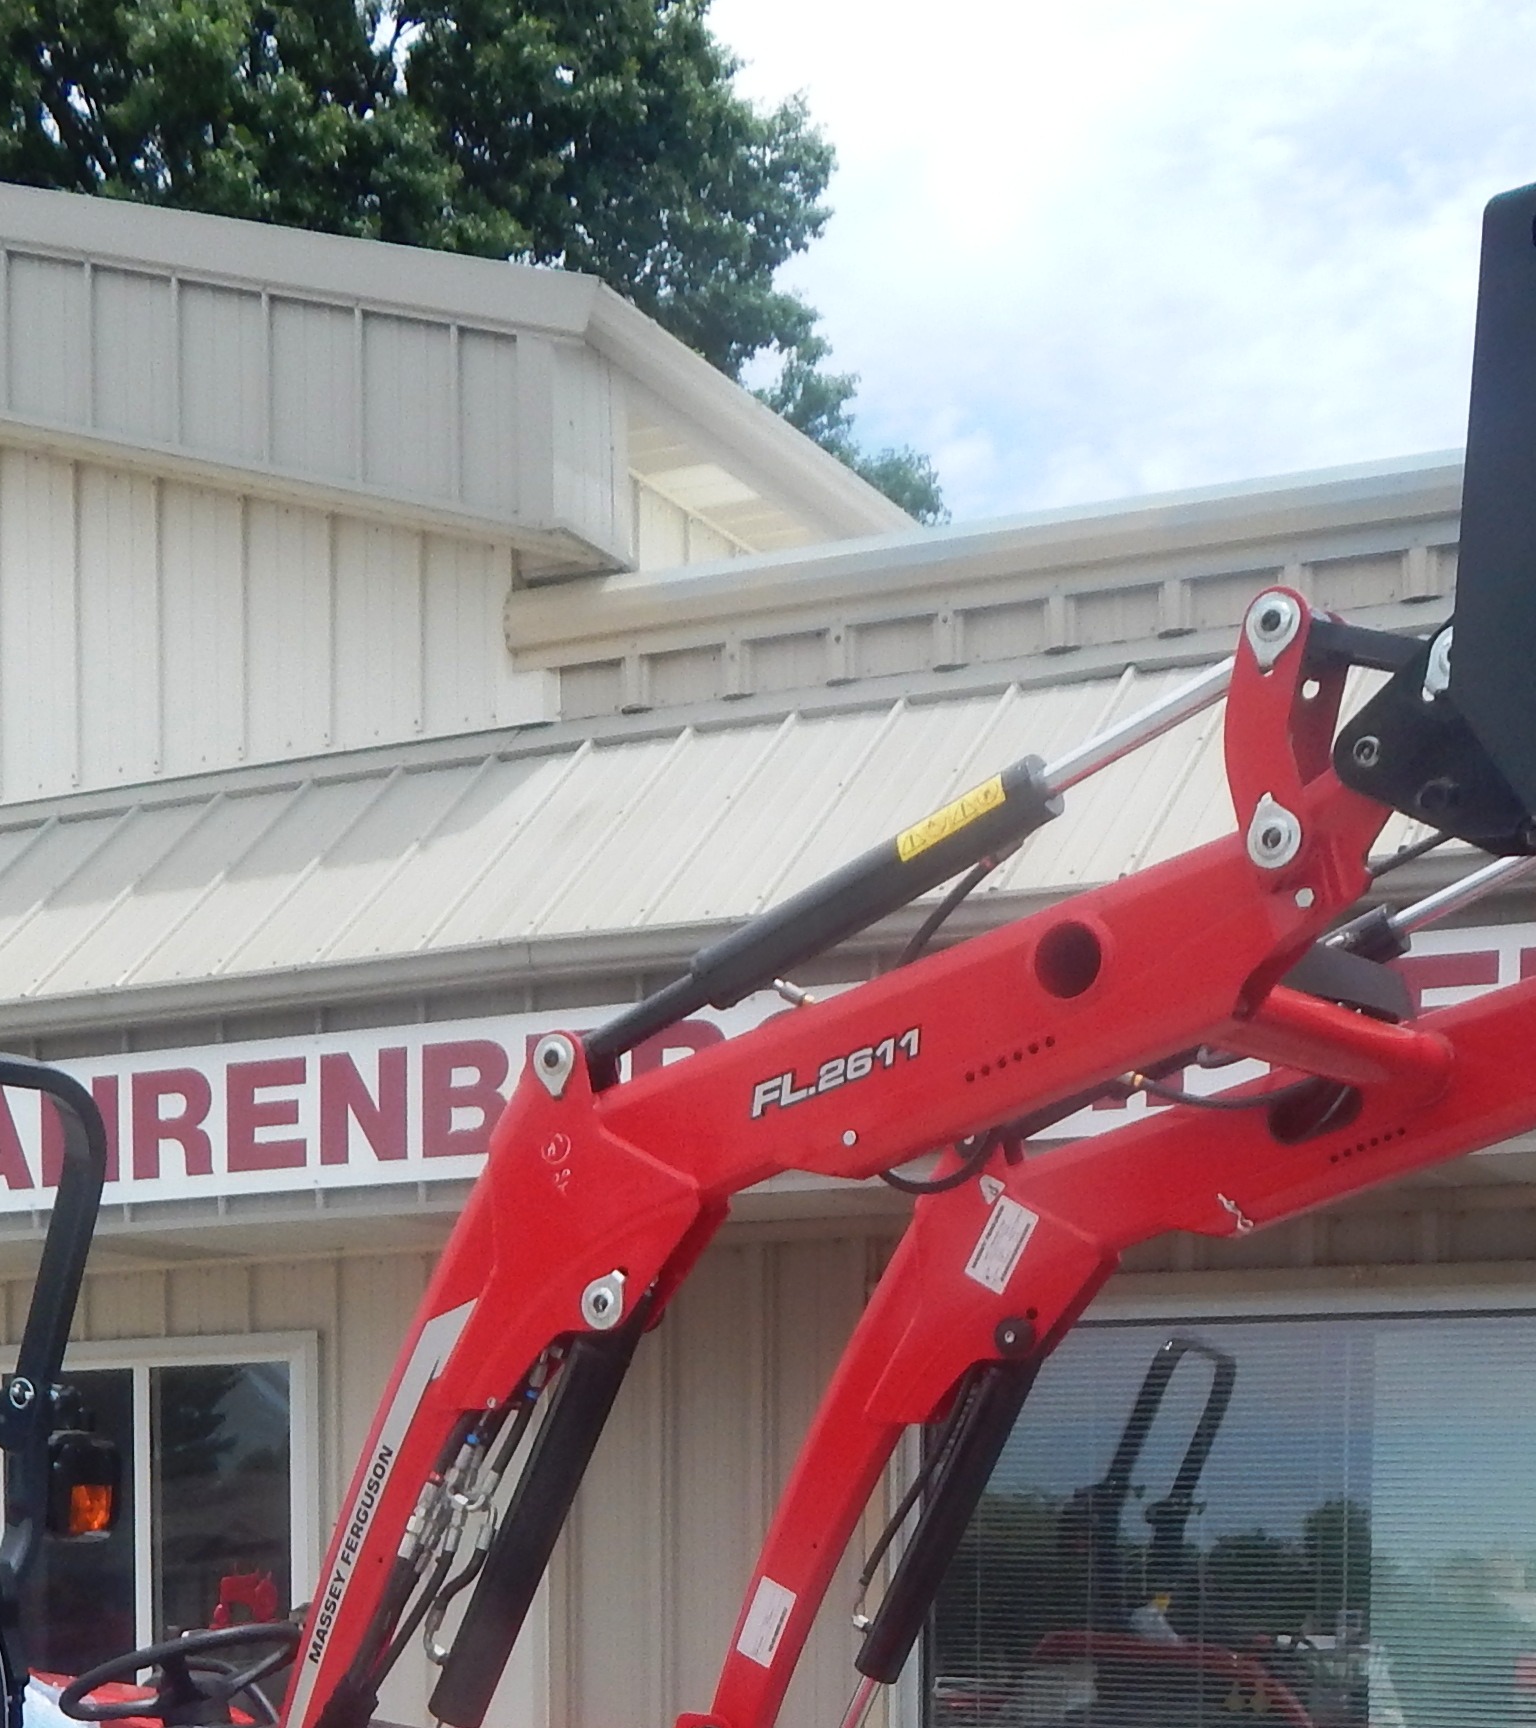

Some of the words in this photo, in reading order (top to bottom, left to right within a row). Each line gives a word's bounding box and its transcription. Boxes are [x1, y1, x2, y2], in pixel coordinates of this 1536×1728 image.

[751, 1026, 921, 1119] FL.2611
[308, 1568, 346, 1665] MASSEY
[340, 1444, 394, 1567] FERGUSON
